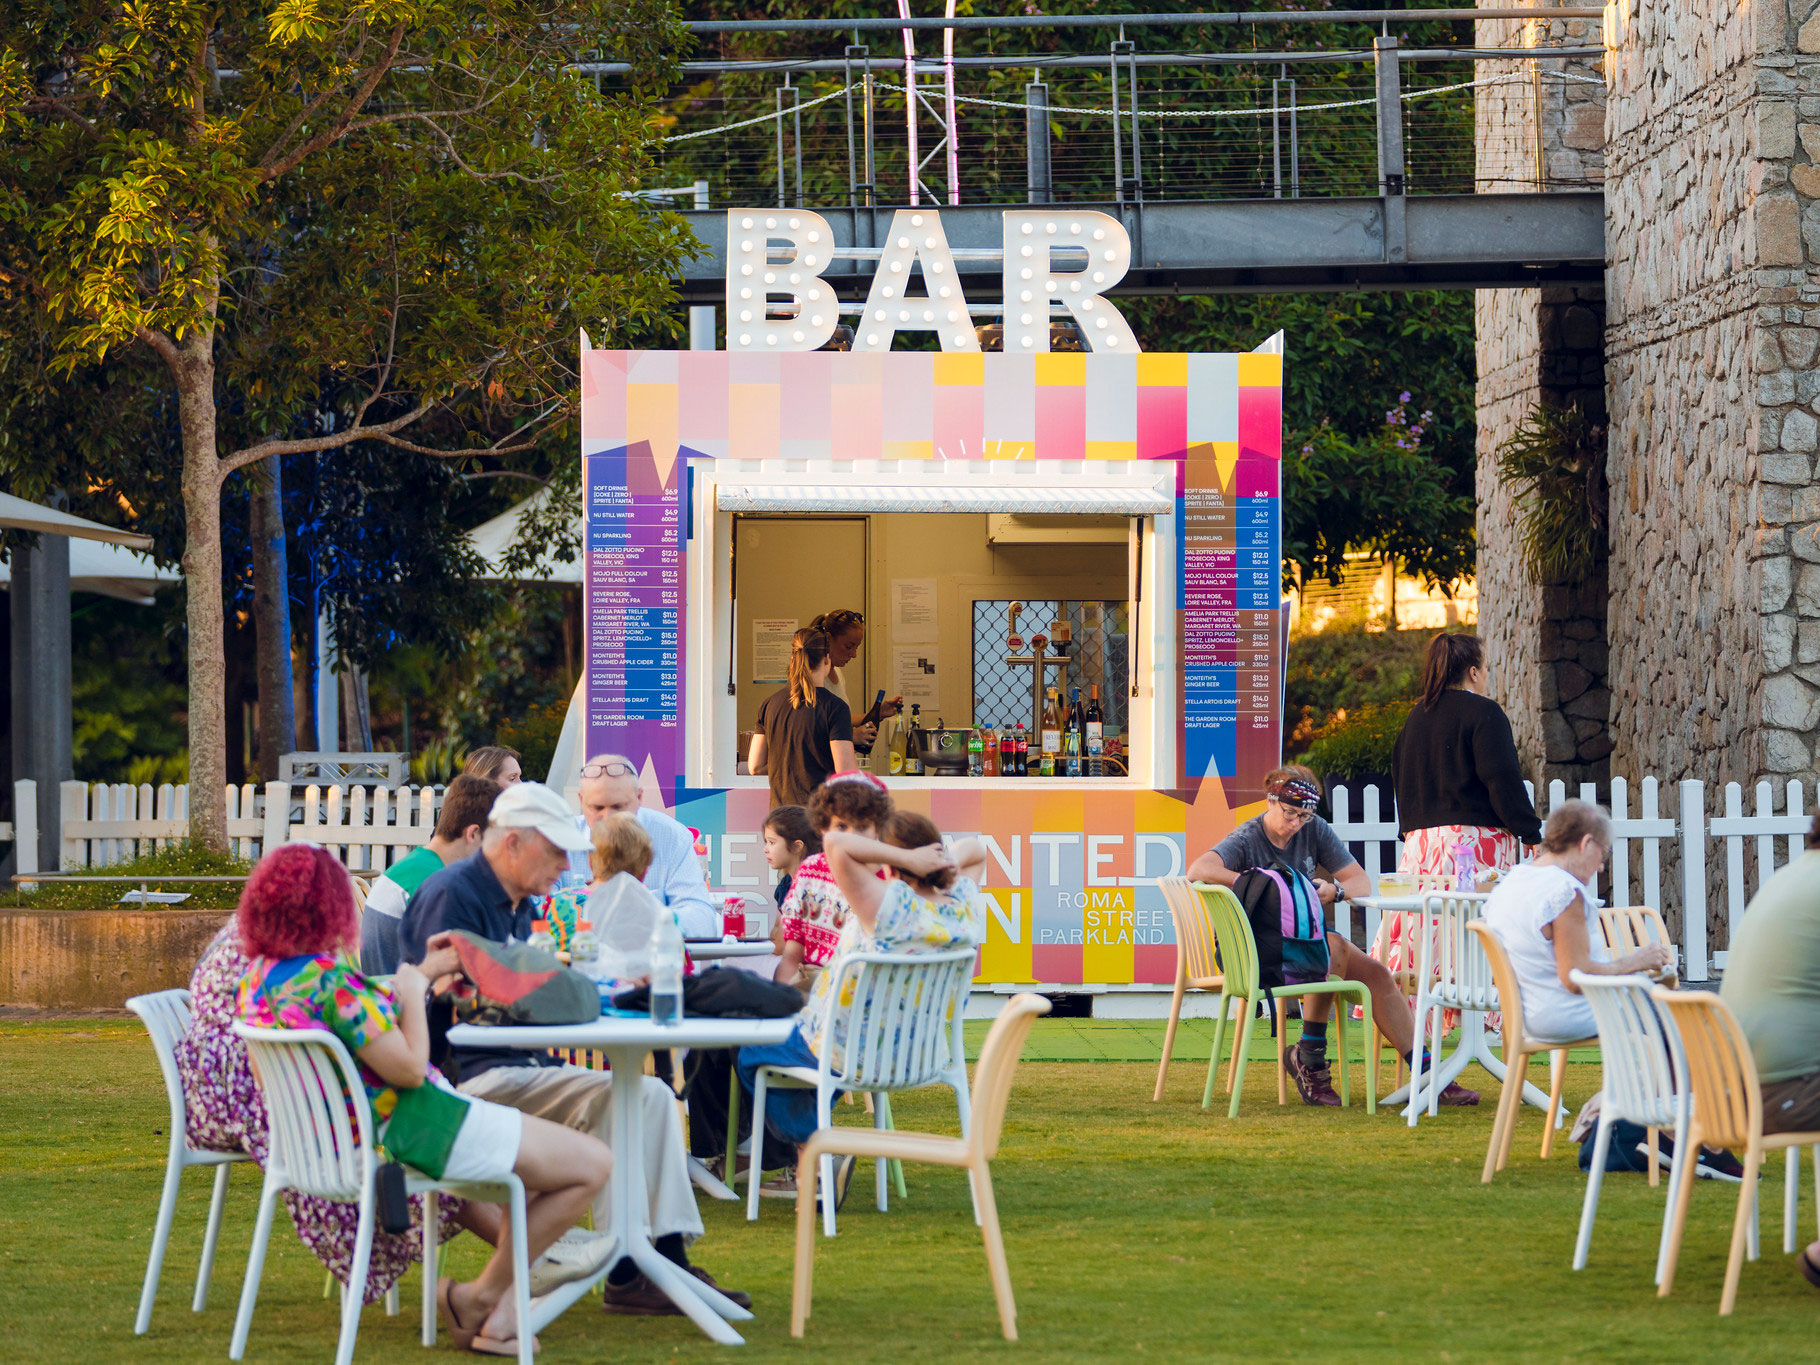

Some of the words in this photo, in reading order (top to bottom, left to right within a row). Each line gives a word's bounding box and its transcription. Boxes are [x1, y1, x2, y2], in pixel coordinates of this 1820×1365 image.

[726, 208, 1142, 353] BAR
[721, 834, 1182, 886] ENTED
[1058, 892, 1126, 908] ROMA
[1040, 928, 1164, 944] PARKLAND
